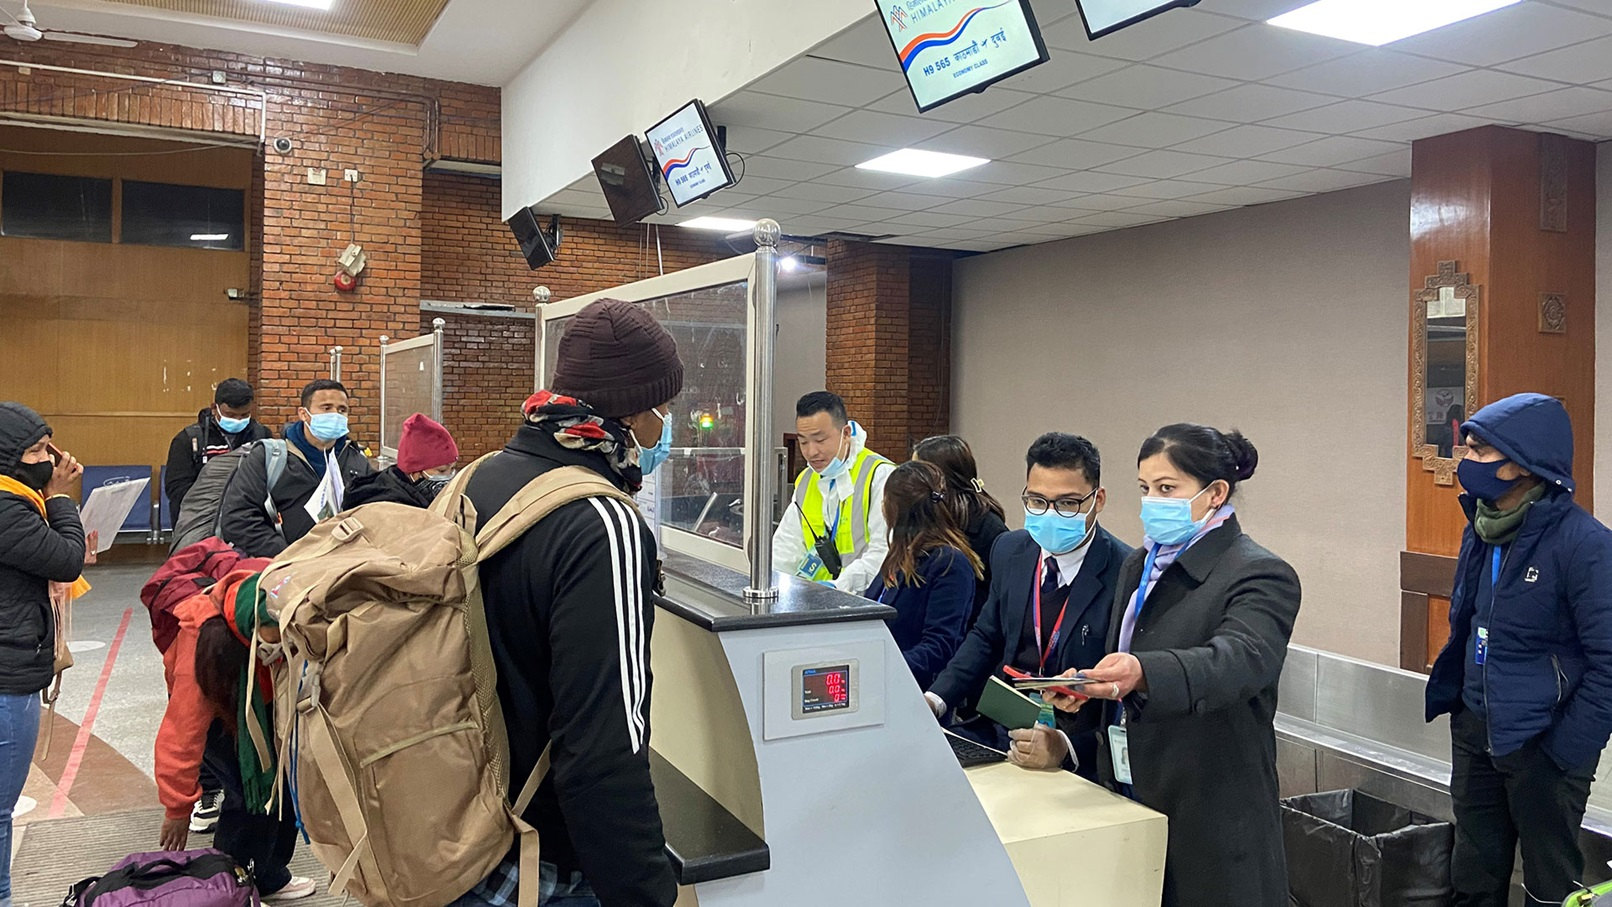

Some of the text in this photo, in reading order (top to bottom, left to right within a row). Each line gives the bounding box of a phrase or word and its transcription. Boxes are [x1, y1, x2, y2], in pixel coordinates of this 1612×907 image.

[922, 64, 935, 76] H9
[935, 57, 951, 71] 565
[953, 59, 988, 78] ECONOMY CLASS
